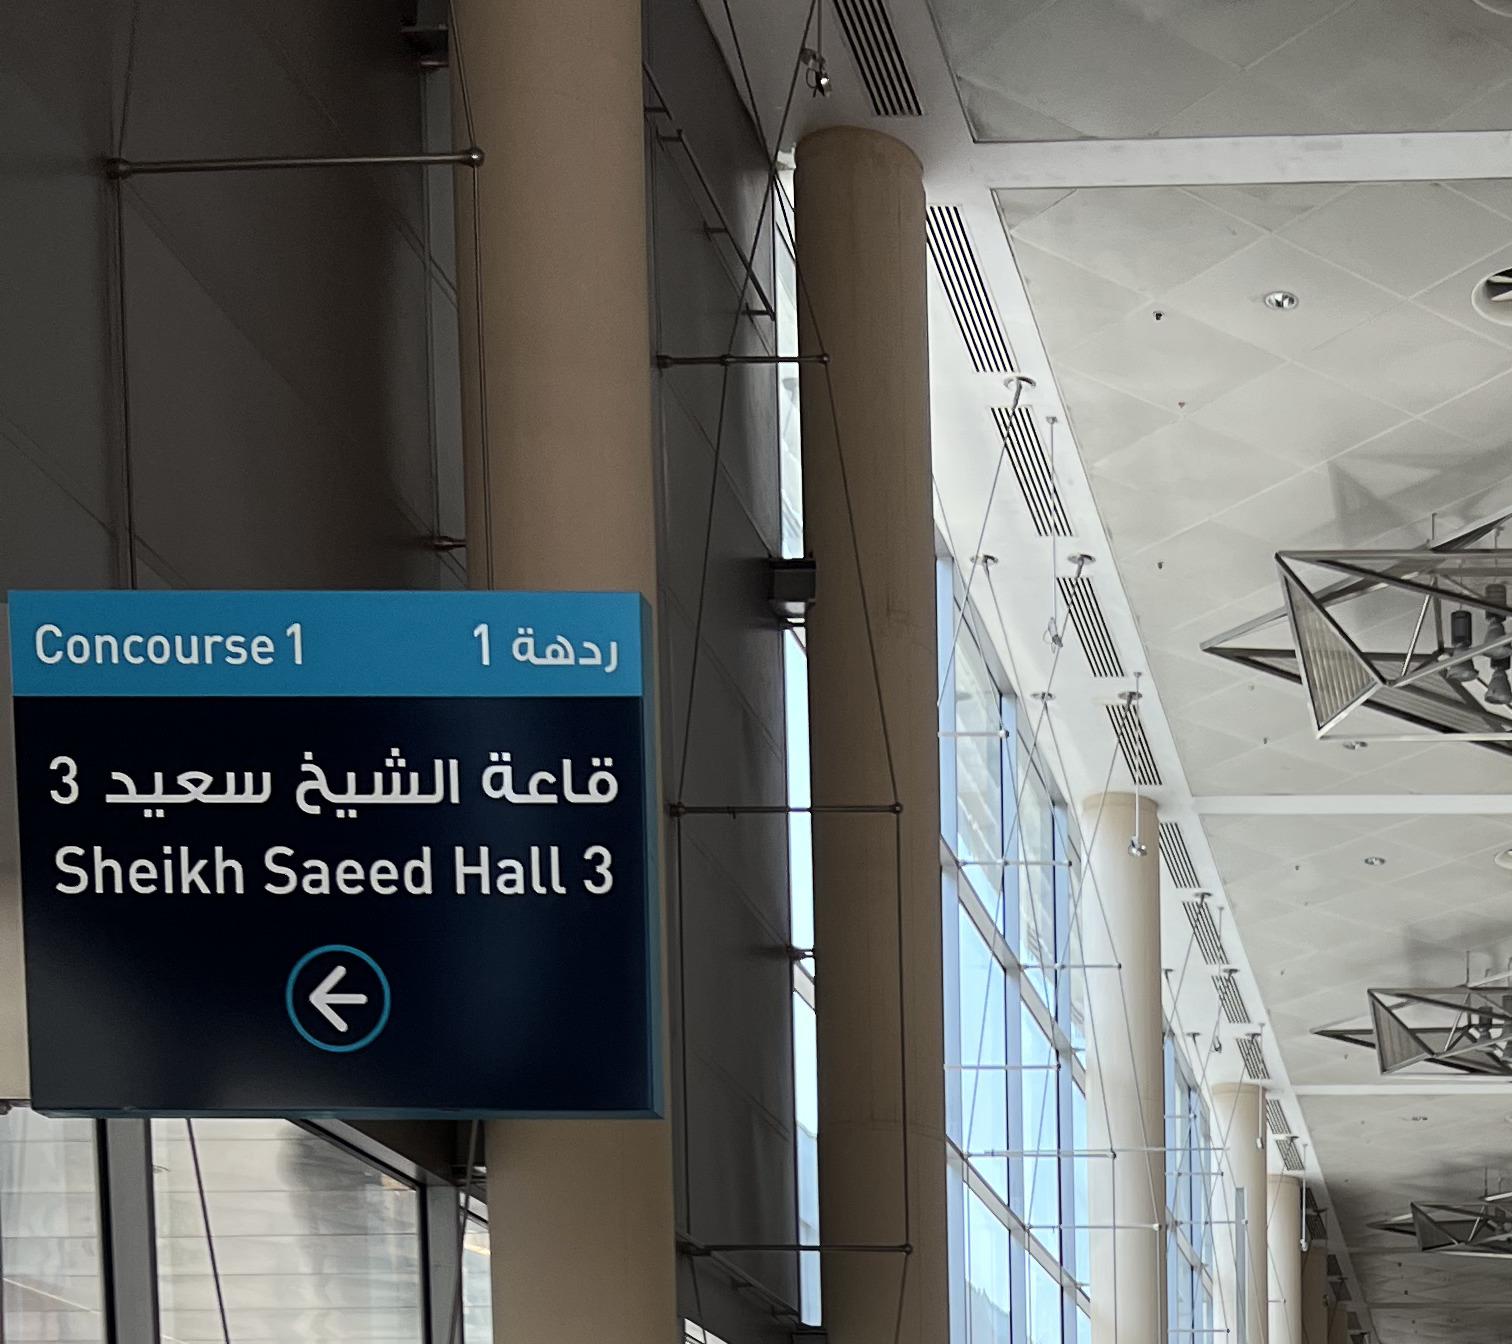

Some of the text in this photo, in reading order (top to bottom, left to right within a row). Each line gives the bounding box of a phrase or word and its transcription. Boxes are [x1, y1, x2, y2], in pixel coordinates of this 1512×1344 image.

[34, 623, 304, 666] Concourse 1
[473, 623, 619, 673] ردهة 1
[48, 747, 619, 819] قاعة الشيخ سعيد 3
[54, 845, 614, 895] Sheikh Saeed Hall 3
